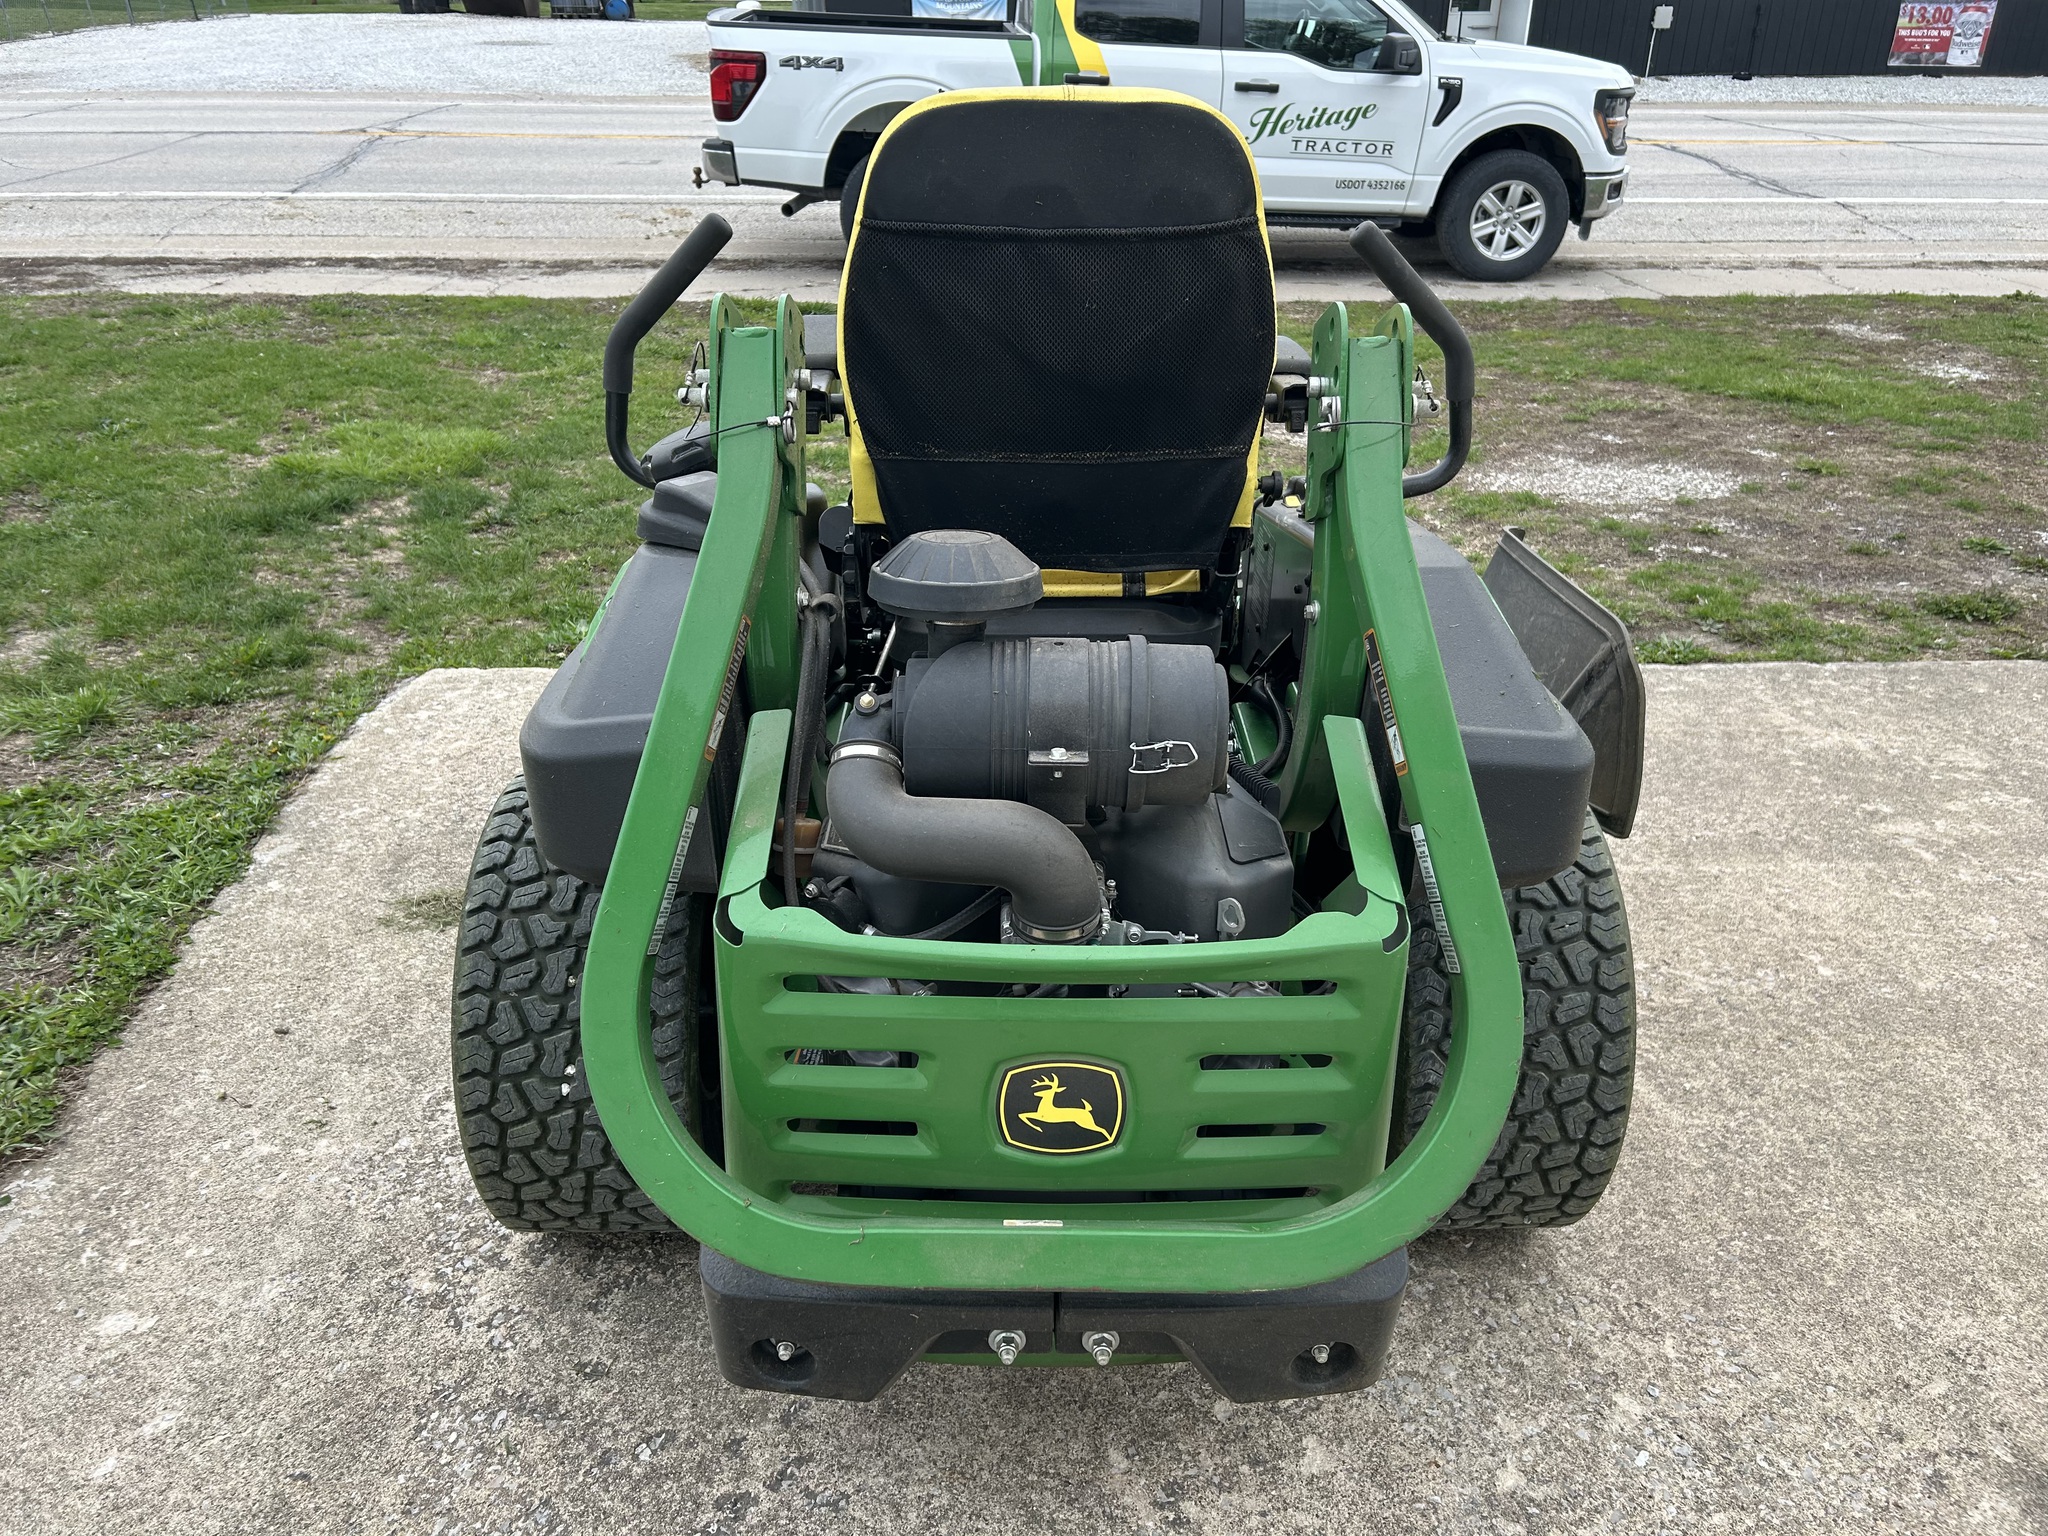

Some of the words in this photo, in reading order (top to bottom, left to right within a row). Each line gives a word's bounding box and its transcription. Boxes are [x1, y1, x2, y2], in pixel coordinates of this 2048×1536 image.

[935, 2, 983, 10] MOUNTAINS
[1901, 4, 1953, 24] $13.00
[1928, 29, 1939, 37] FOR
[1245, 102, 1379, 145] Heritage
[1291, 139, 1394, 155] TRACTOR
[1335, 179, 1366, 190] USDOT
[1367, 180, 1406, 191] 4352166
